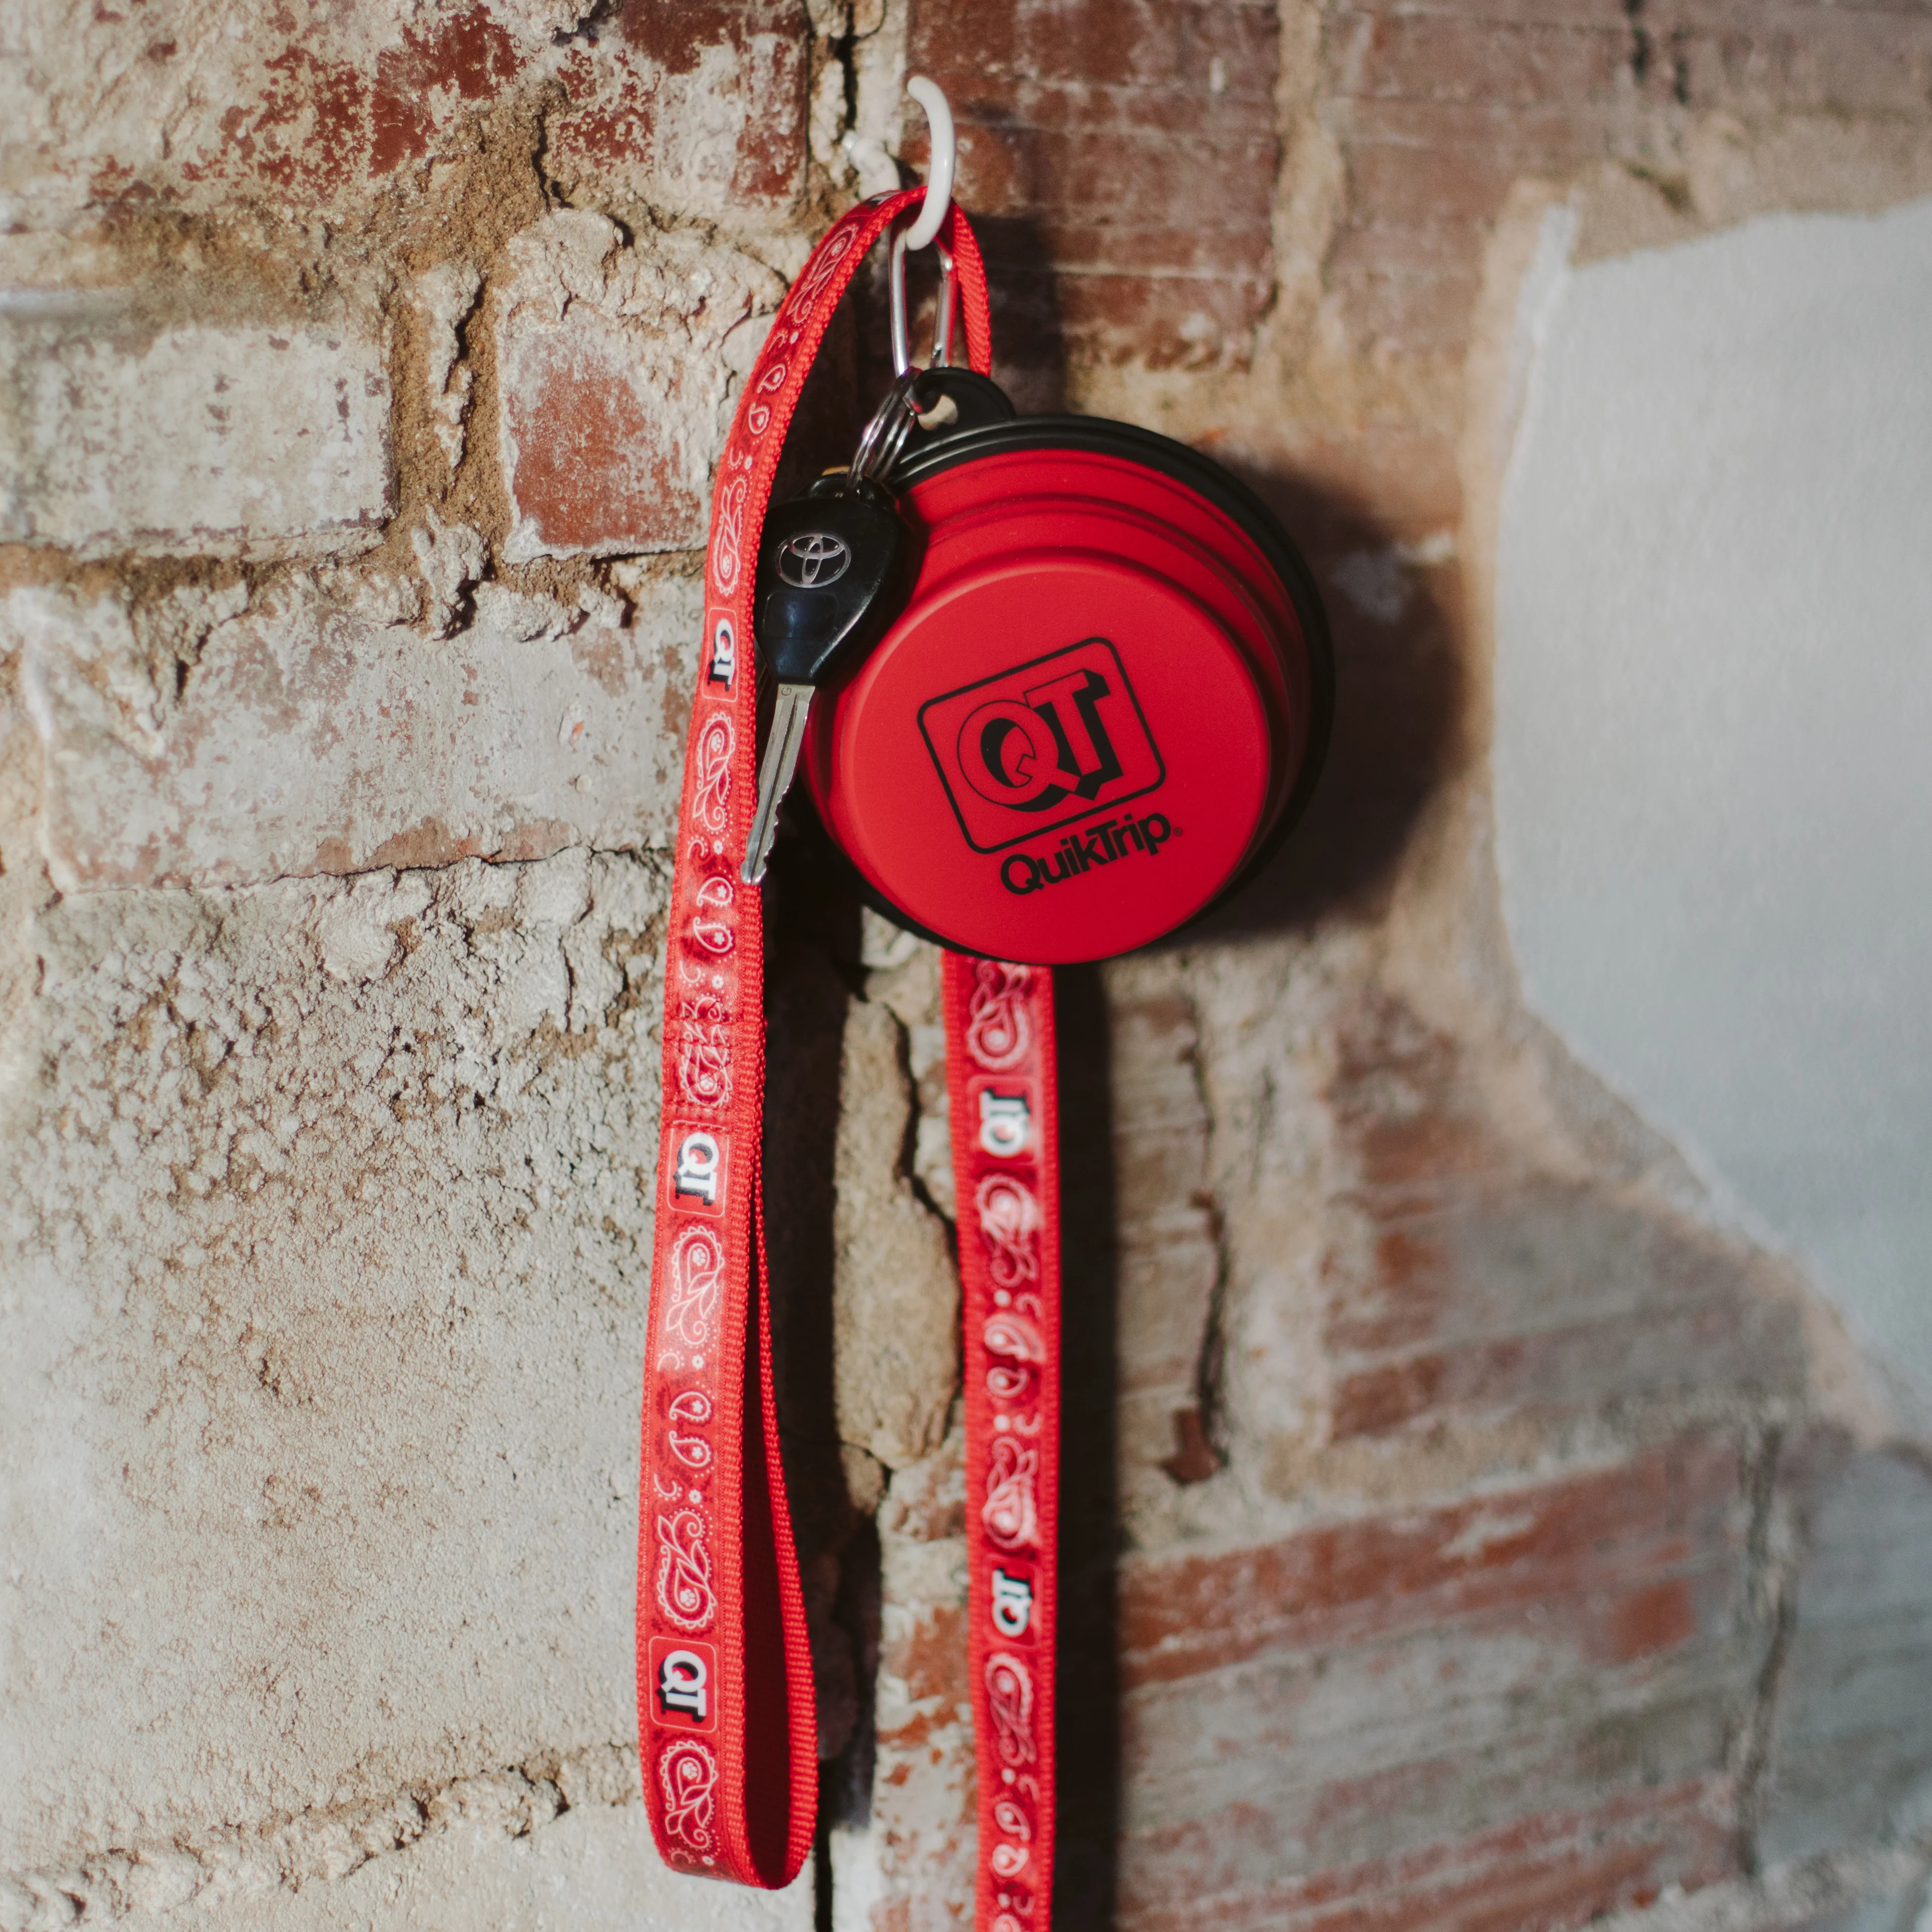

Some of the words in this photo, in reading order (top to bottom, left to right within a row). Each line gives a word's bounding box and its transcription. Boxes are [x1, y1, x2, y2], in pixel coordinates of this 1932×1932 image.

[707, 619, 735, 691] QT
[957, 668, 1124, 812] QT
[1000, 812, 1171, 895] QuikTrip
[980, 1087, 1030, 1158] QT
[673, 1132, 719, 1206] QT
[991, 1567, 1034, 1638] QT
[656, 1650, 707, 1722] QT
